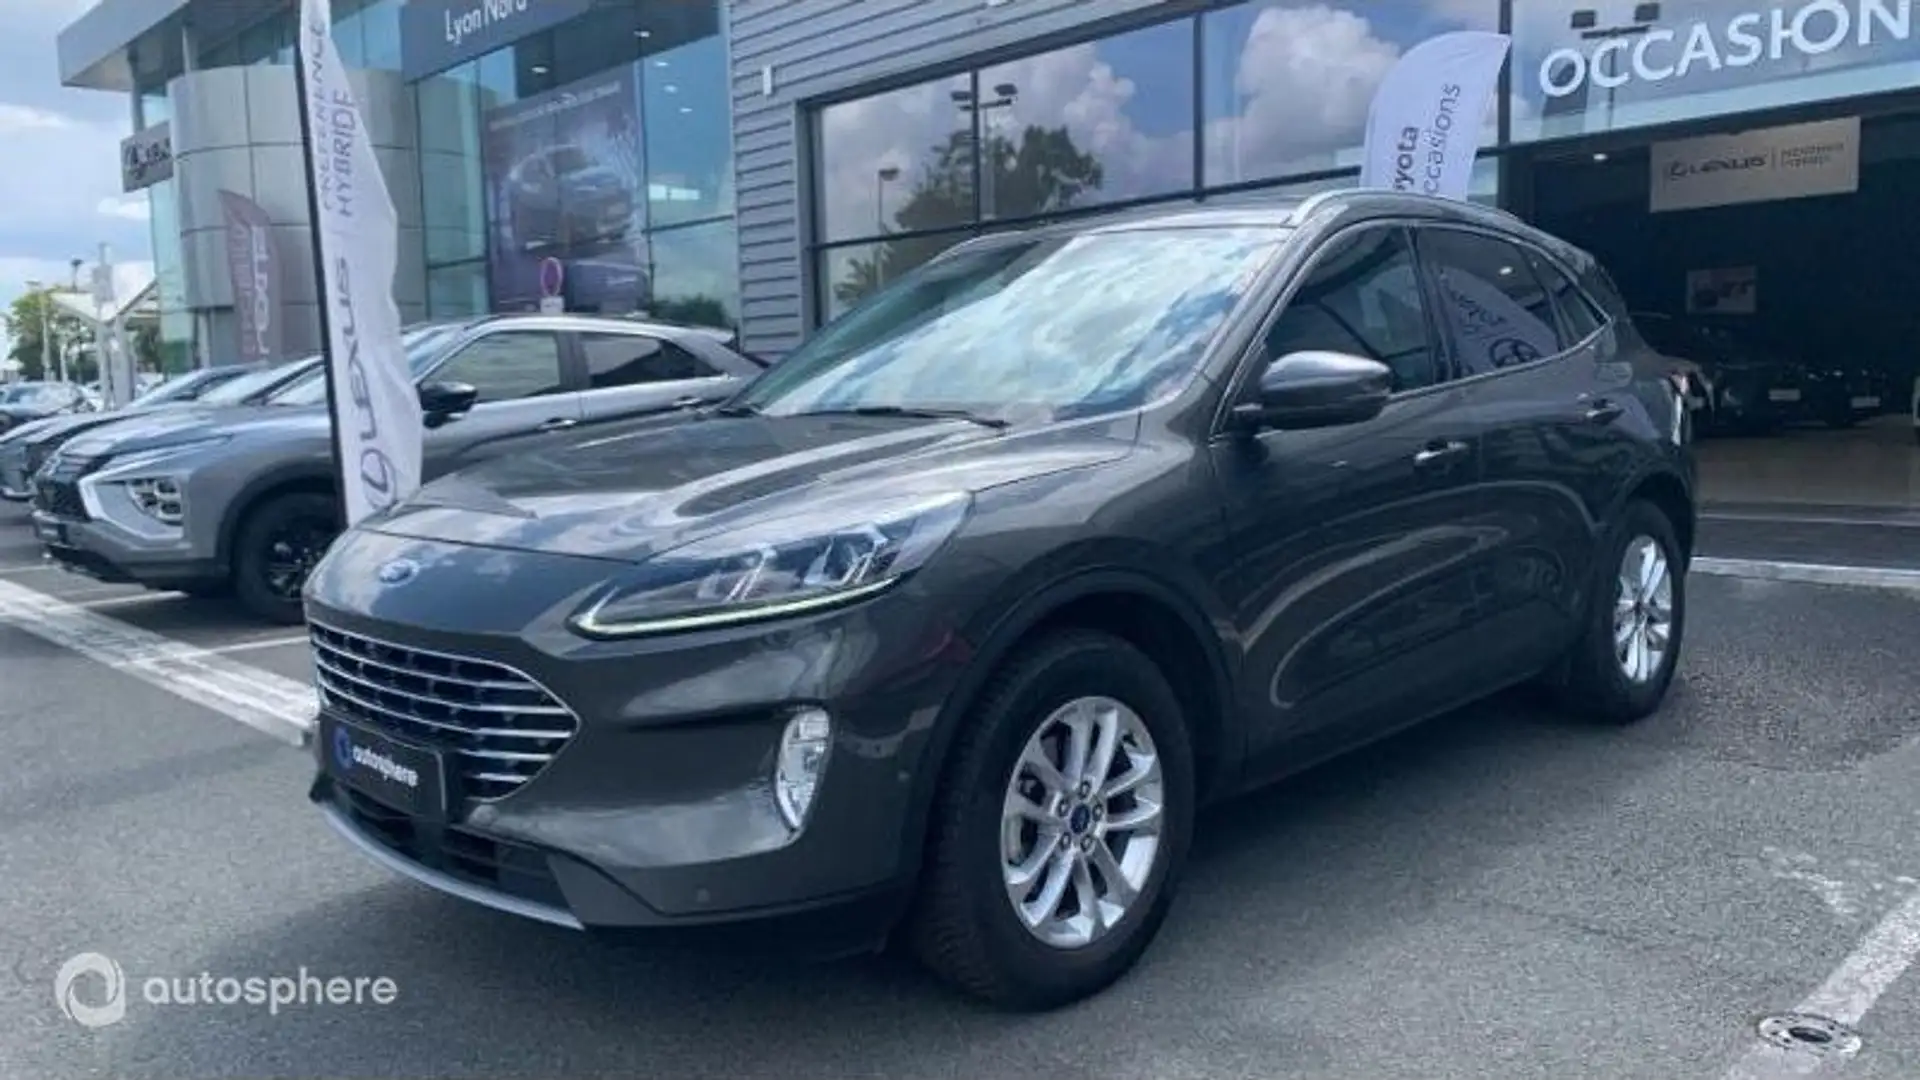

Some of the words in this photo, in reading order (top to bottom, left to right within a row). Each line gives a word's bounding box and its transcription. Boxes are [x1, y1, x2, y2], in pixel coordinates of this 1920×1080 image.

[444, 8, 481, 45] Lyon
[1423, 83, 1461, 194] ccasions
[336, 257, 377, 442] LEXUS
[352, 745, 418, 787] autosphere
